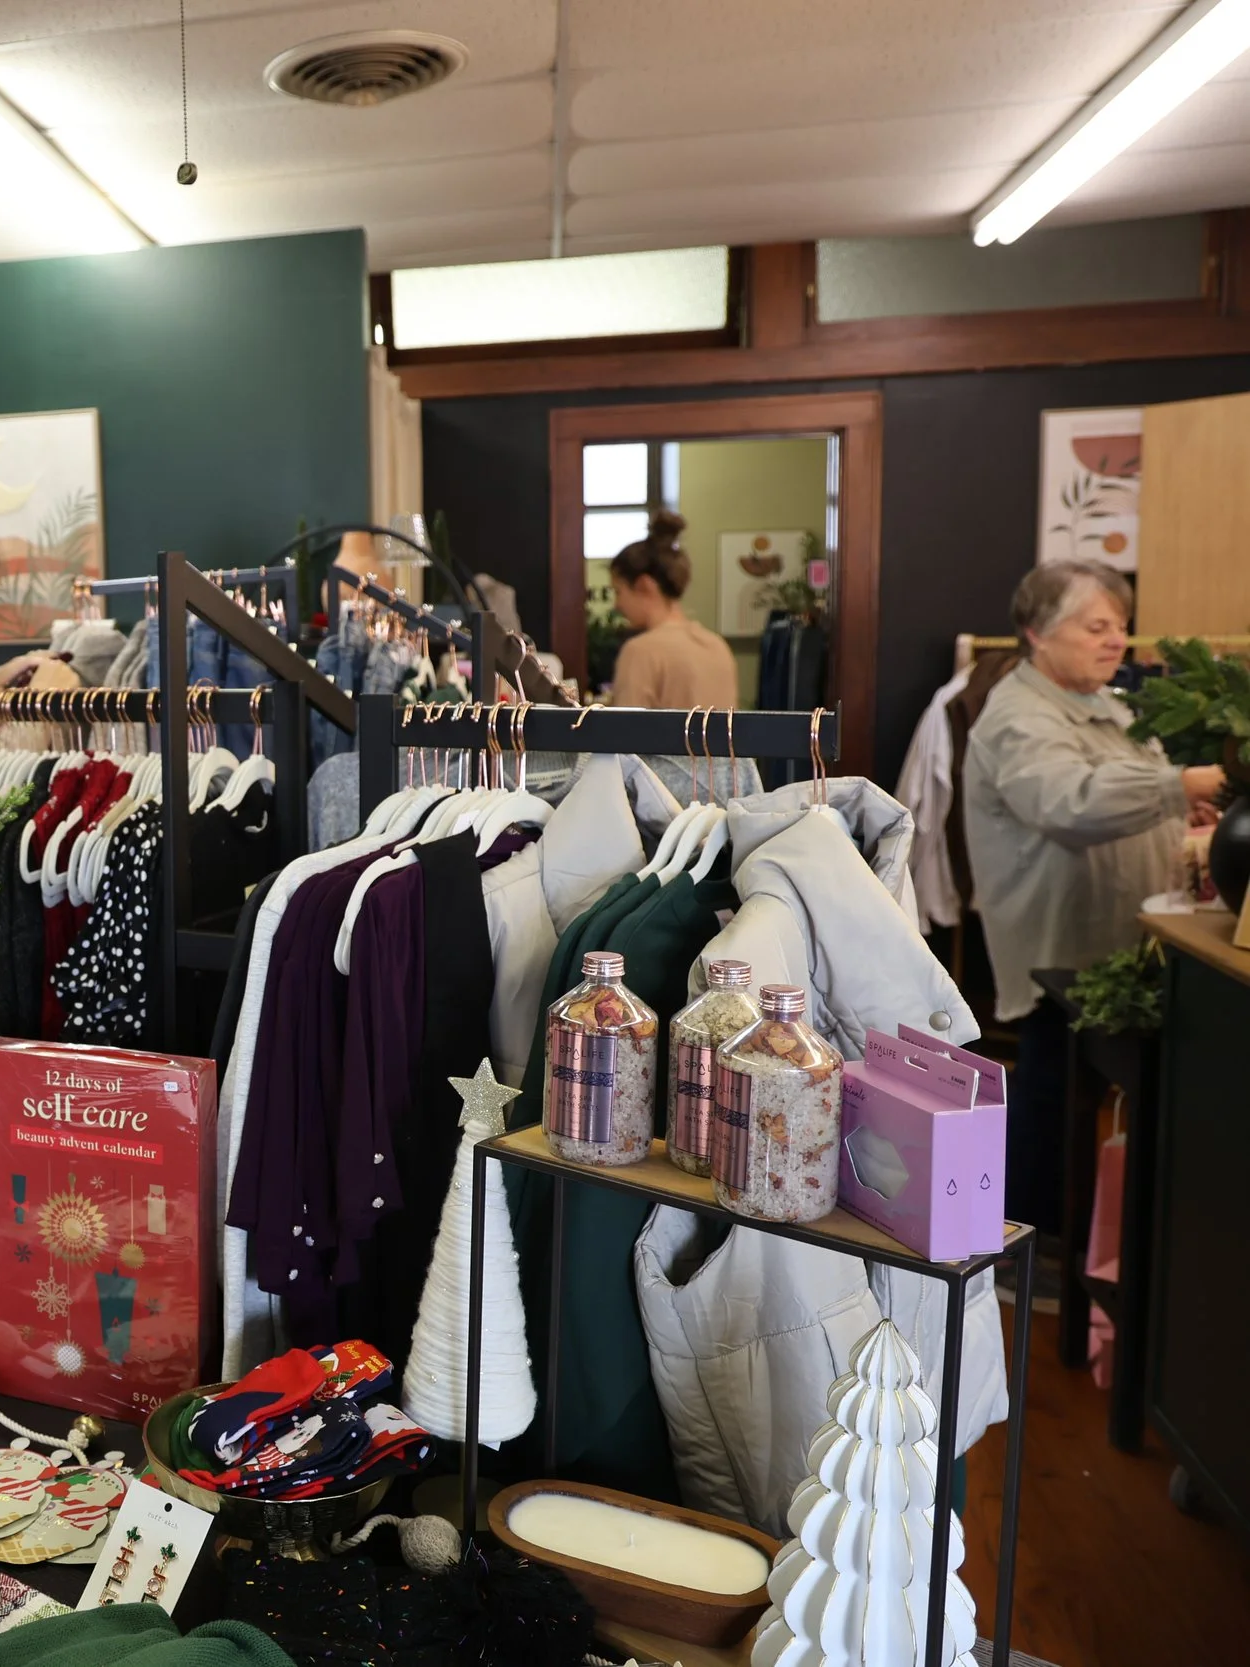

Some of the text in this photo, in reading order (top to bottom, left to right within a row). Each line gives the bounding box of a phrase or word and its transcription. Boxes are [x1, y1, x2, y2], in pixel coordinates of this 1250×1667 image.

[558, 1044, 605, 1060] SPALIFE
[869, 1041, 897, 1060] SPALIFE
[684, 1060, 713, 1076] SPAL
[45, 1070, 123, 1093] 12 days of
[22, 1093, 148, 1132] self care
[17, 1128, 157, 1159] beauty advent calendar
[133, 1392, 162, 1410] SPAL
